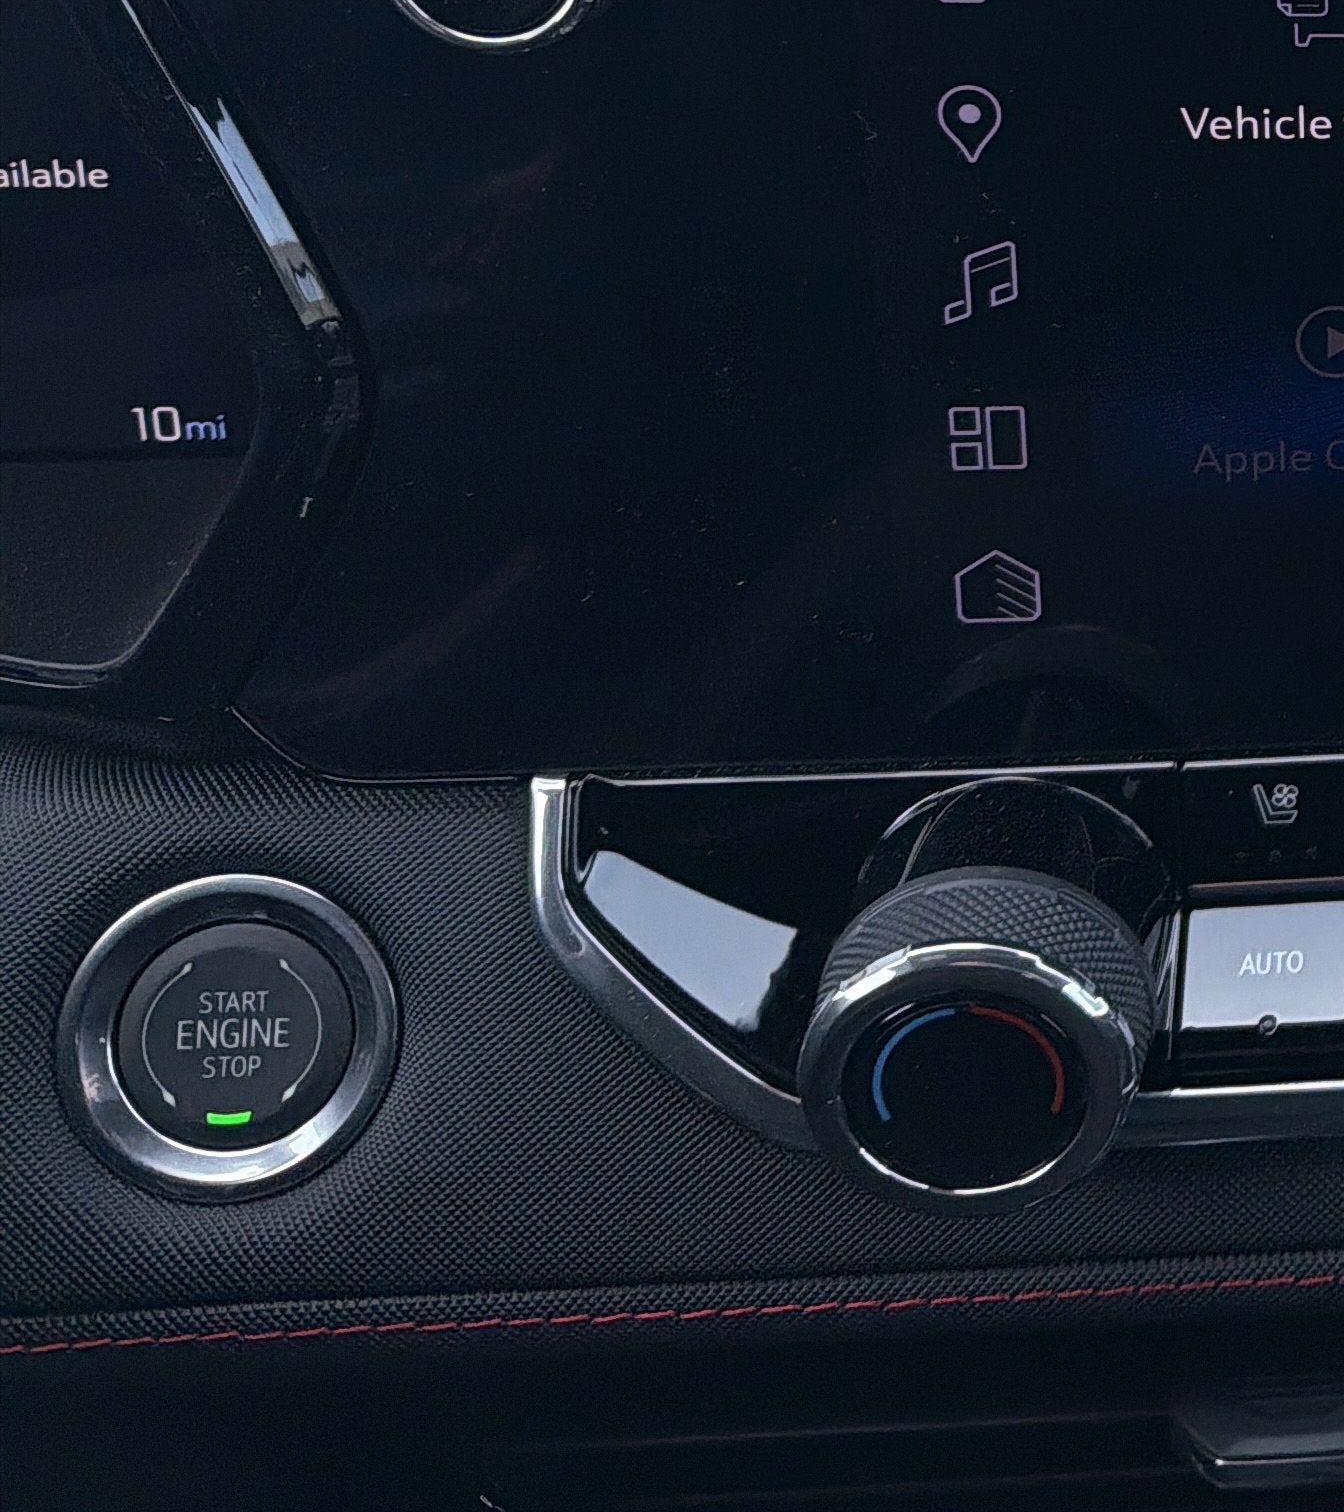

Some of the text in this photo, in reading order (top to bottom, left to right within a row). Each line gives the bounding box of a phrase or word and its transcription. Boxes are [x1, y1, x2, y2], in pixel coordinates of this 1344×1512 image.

[1180, 103, 1333, 141] Vehicle
[1193, 440, 1313, 483] Apple
[1237, 949, 1305, 977] AUTO
[198, 989, 270, 1015] START
[175, 1016, 291, 1051] ENGINE
[201, 1054, 262, 1080] STOP
